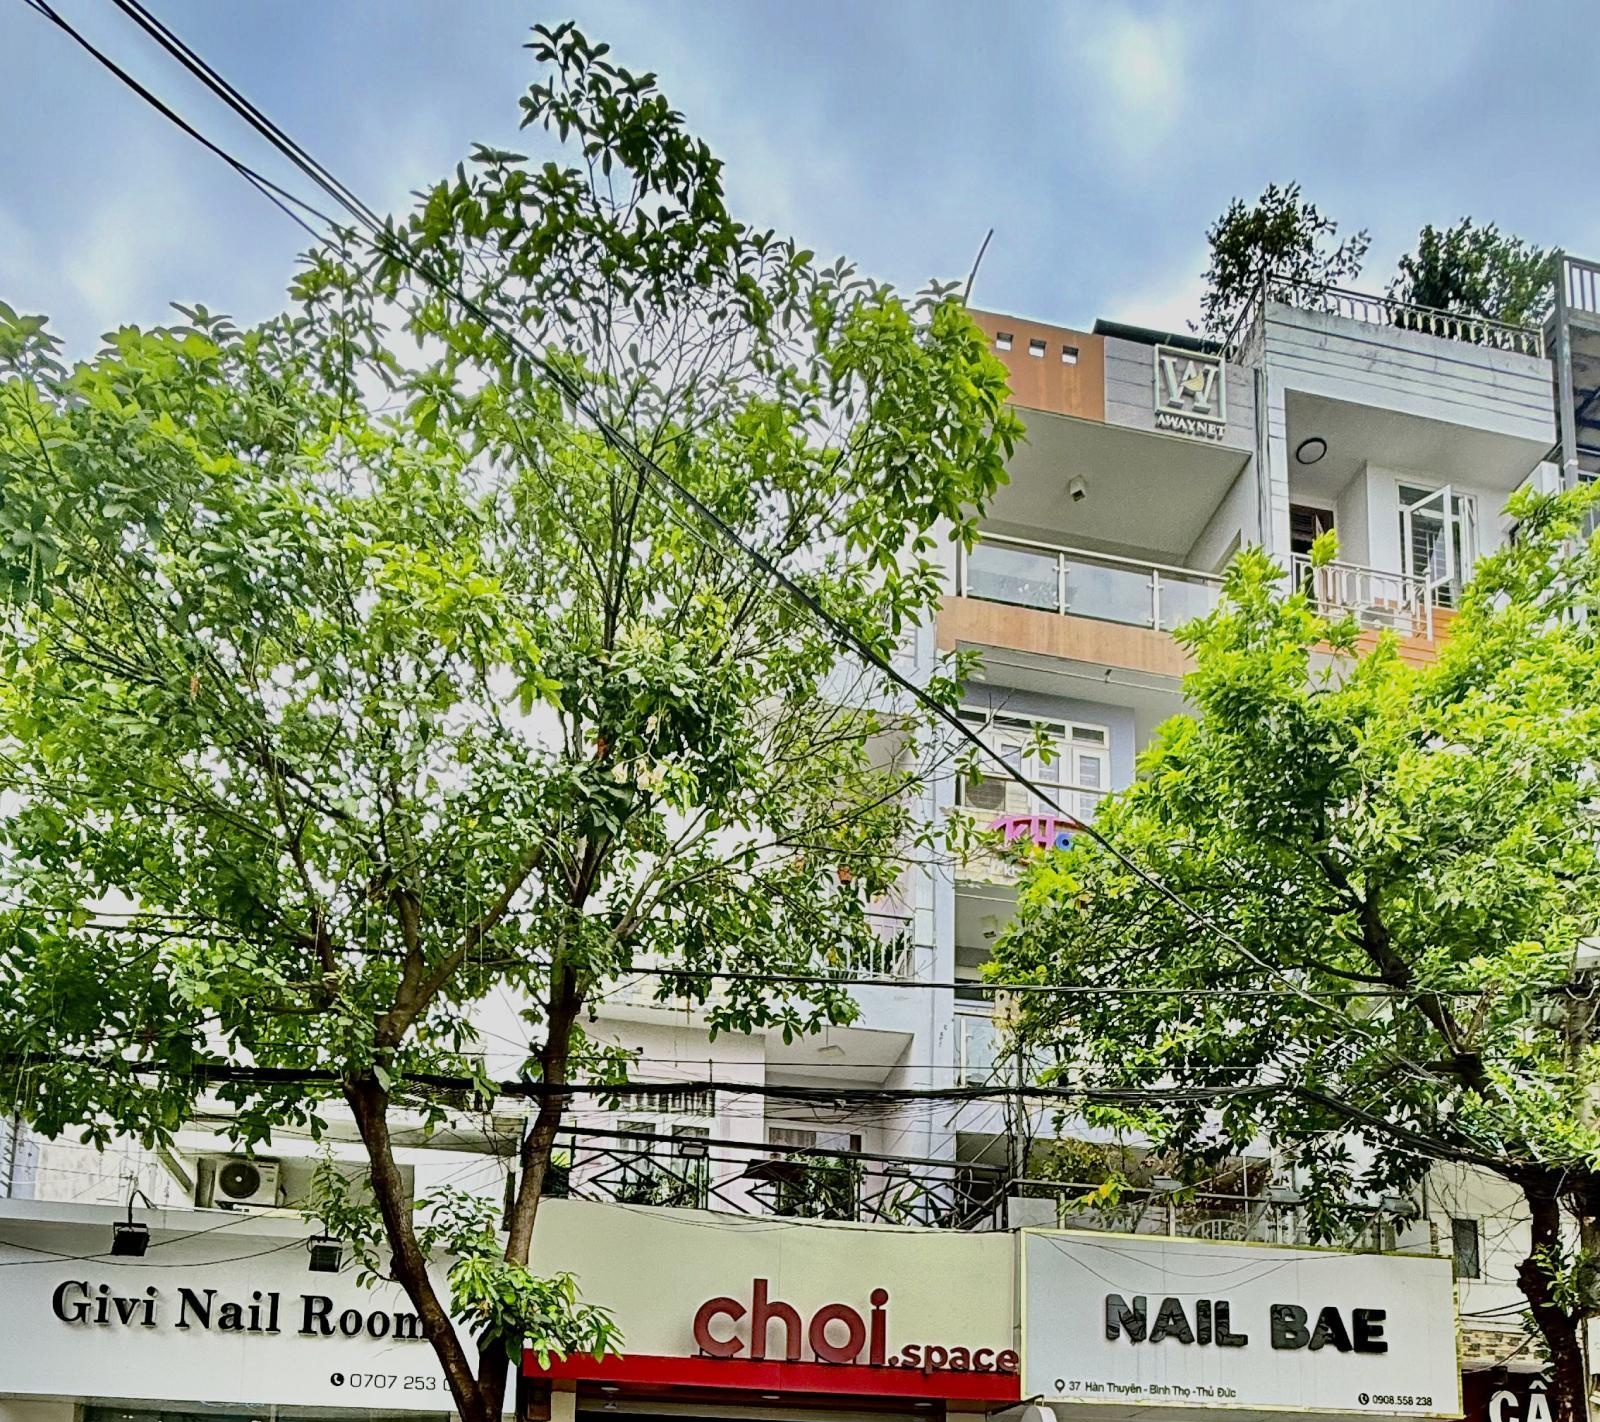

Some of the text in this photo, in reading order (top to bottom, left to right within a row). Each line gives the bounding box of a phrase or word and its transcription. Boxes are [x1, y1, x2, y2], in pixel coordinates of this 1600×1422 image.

[1156, 413, 1226, 438] AWAYNET
[52, 1279, 159, 1327] Givi
[175, 1287, 281, 1334] Nail
[1105, 1293, 1389, 1353] NAIL BAE
[350, 1373, 398, 1389] 0707
[403, 1375, 436, 1391] 253
[1069, 1381, 1081, 1392] 37
[1085, 1382, 1104, 1393] Hàn
[1217, 1387, 1237, 1398] Đức
[1416, 1396, 1433, 1407] 238
